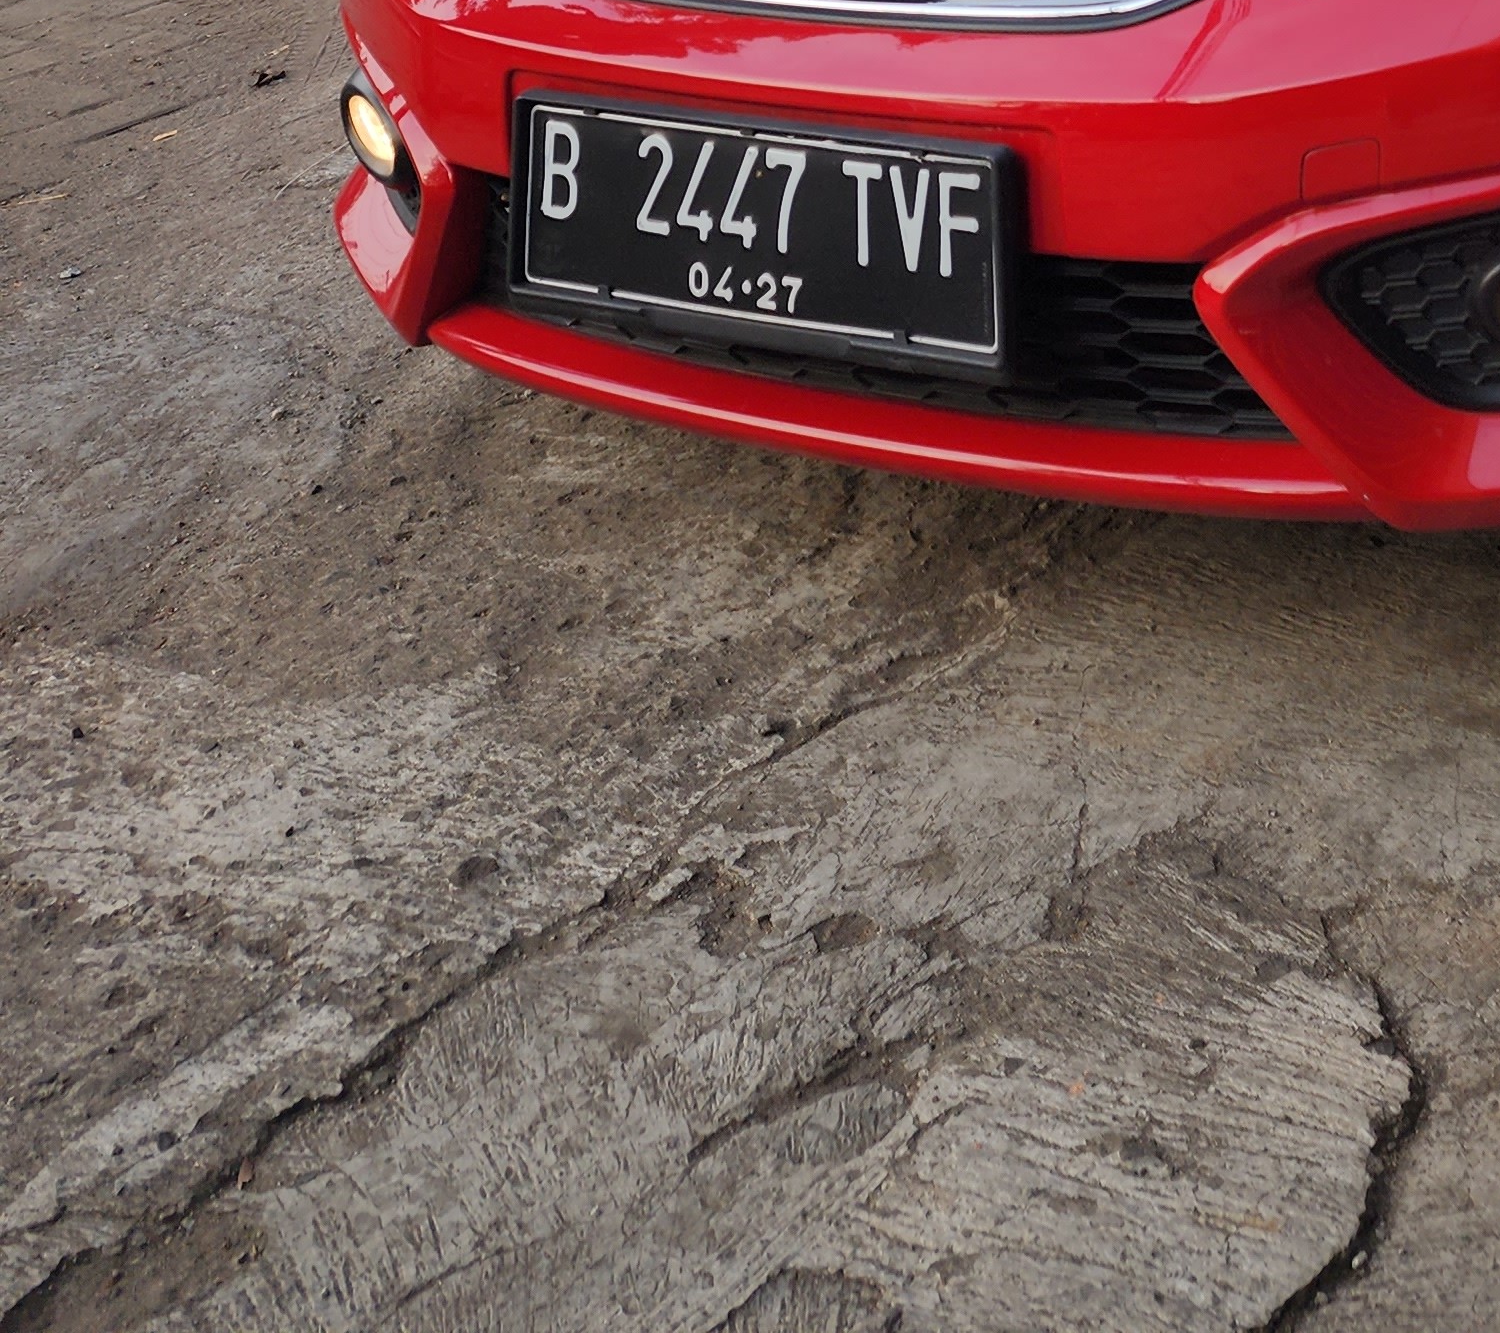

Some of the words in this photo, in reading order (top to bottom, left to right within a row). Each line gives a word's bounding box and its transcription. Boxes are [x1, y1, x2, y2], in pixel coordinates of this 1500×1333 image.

[540, 119, 580, 220] B
[636, 133, 806, 254] 2447
[842, 160, 980, 278] TVF
